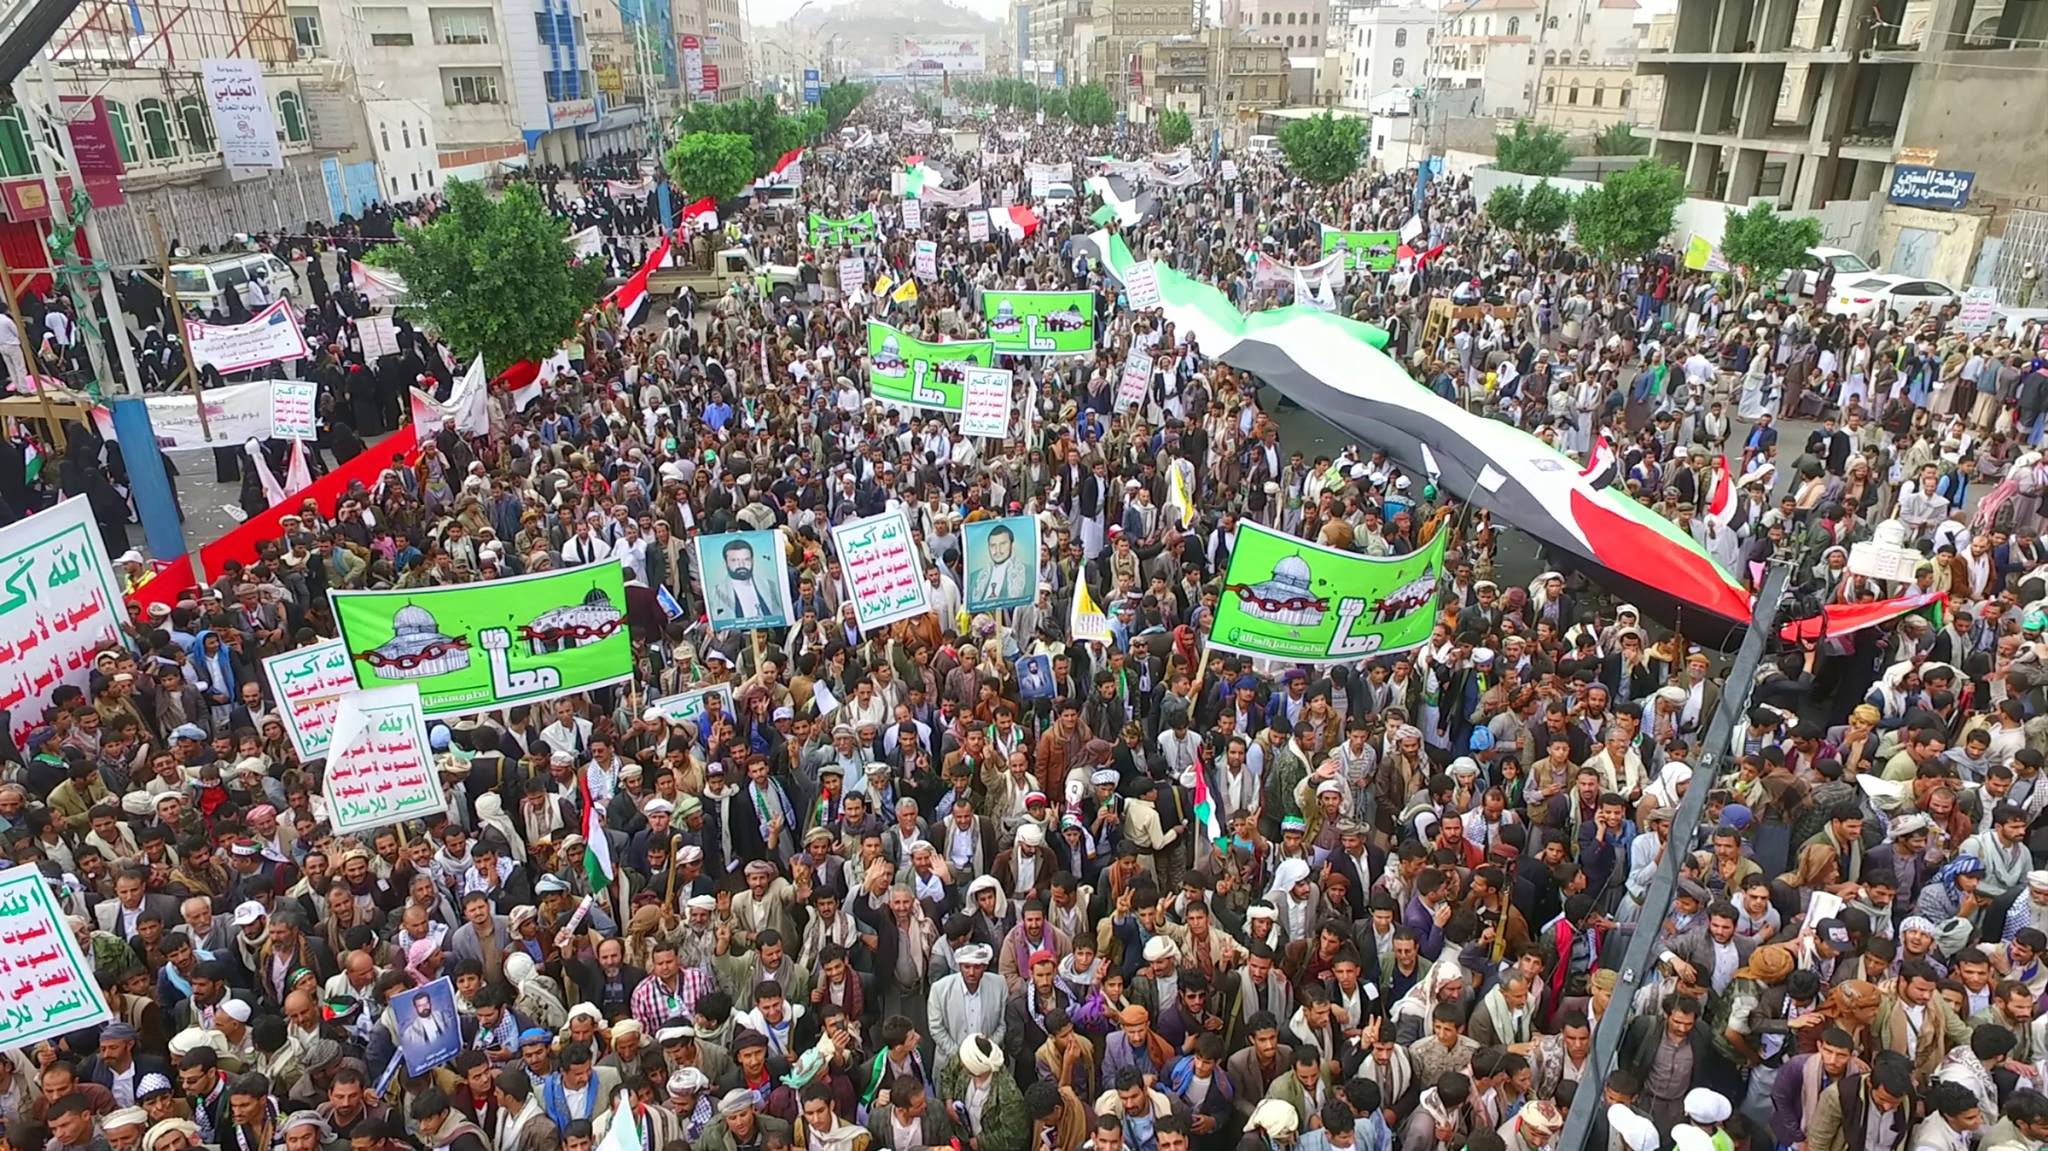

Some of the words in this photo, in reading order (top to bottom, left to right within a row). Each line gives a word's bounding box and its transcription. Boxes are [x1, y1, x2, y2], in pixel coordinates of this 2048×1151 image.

[1935, 171, 1968, 191] ورشة
[847, 526, 877, 554] أكبر
[881, 521, 904, 540] الله
[882, 543, 908, 559] الموت
[48, 543, 92, 590] الله
[886, 558, 912, 574] الموت
[53, 586, 106, 634] الموت
[895, 588, 921, 610] النصر
[282, 654, 320, 685] أكبر
[326, 651, 345, 669] لله
[478, 626, 561, 700] معا
[285, 676, 325, 699] لأمريكا
[299, 713, 326, 731] اليهود
[378, 712, 412, 735] الله
[377, 737, 417, 755] الموت
[331, 760, 379, 780] لإسرائيل
[383, 757, 422, 773] الموت
[335, 782, 370, 799] اليهود
[374, 779, 393, 794] على
[398, 773, 428, 787] اللعنة
[341, 796, 387, 821] للإسلام
[394, 788, 433, 811] النصر
[0, 885, 42, 918] الله
[2, 918, 53, 946] الموت
[15, 943, 65, 970] الموت
[38, 965, 76, 988] اللعنة
[10, 977, 34, 1001] على
[42, 988, 89, 1023] النصر
[0, 1003, 33, 1033] للإس
